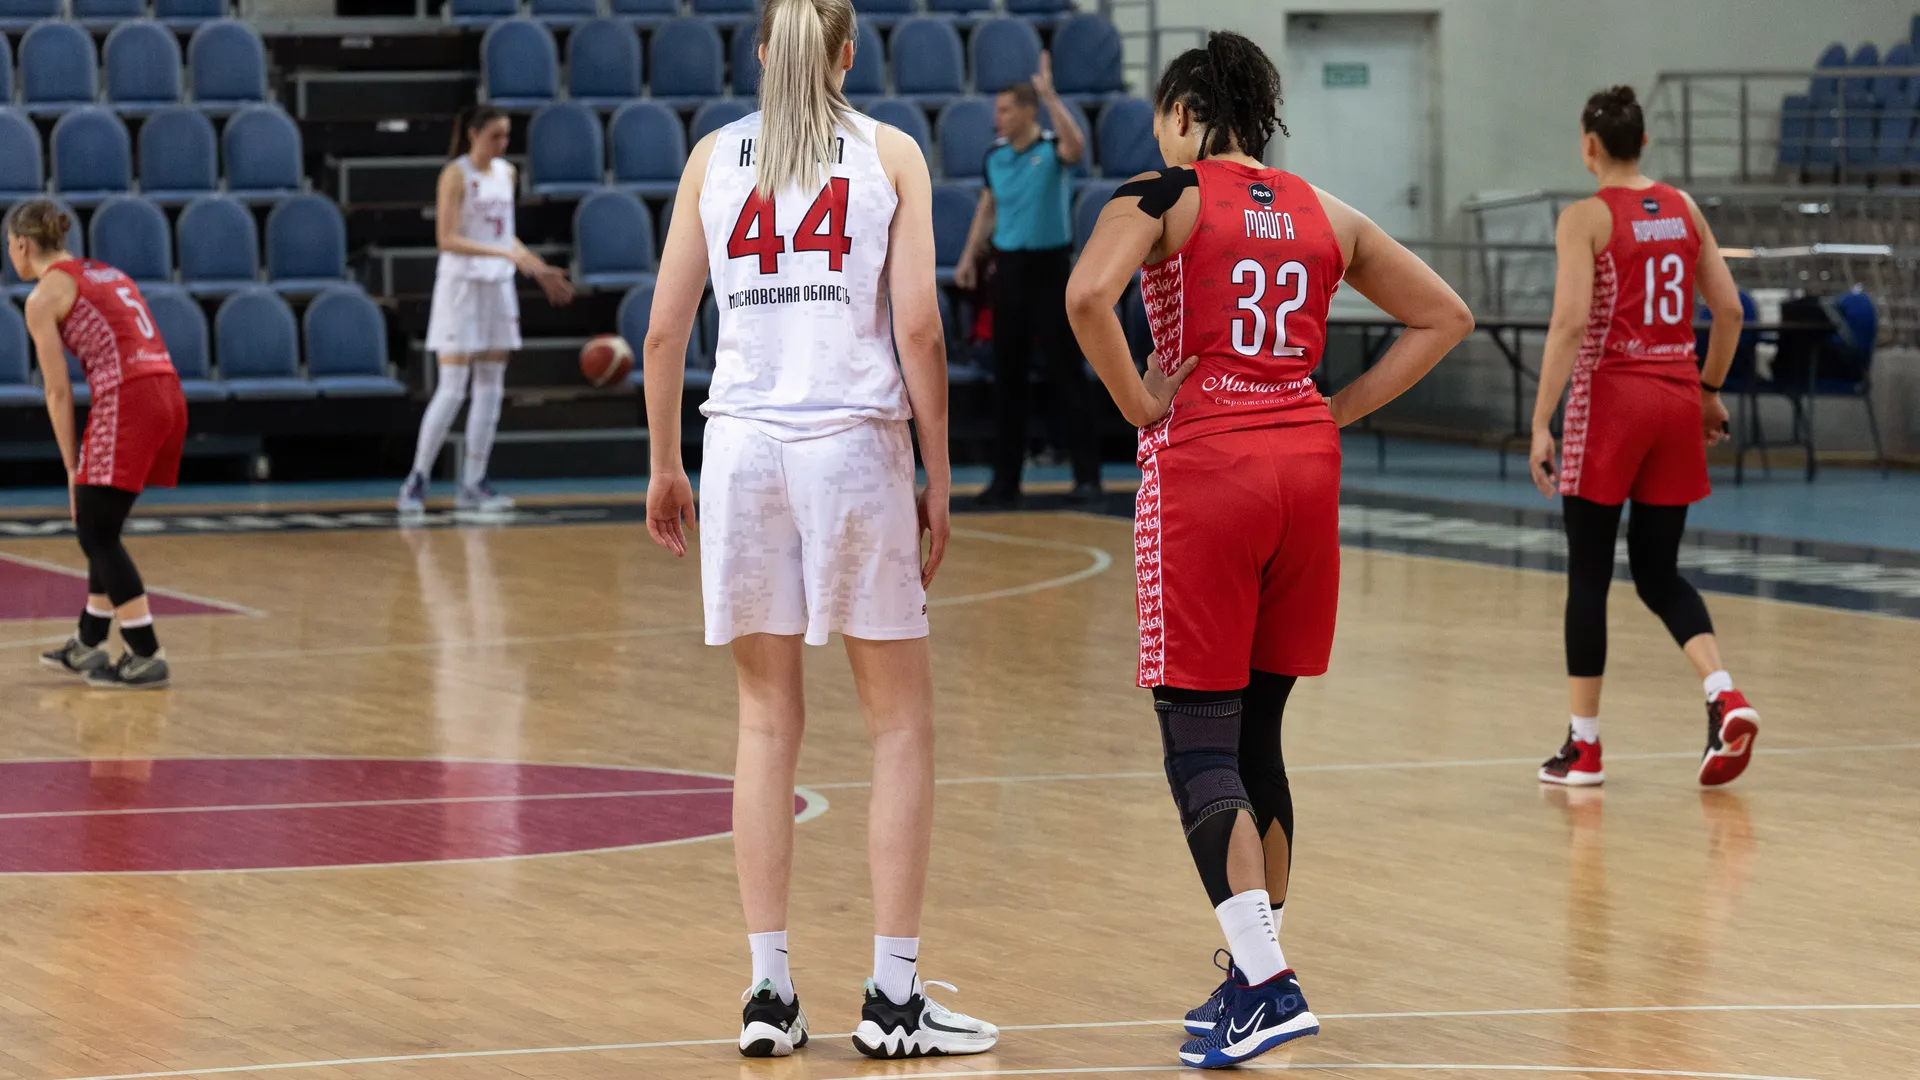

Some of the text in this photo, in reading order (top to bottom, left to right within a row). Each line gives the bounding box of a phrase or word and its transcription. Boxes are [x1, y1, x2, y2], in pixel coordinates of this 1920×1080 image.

[1252, 189, 1272, 198] РФБ
[727, 176, 853, 275] 44
[1244, 205, 1295, 240] МАЙГА
[115, 287, 154, 339] 5
[728, 284, 851, 309] МОСКОВСКАЯ ОБЛАСТЬ
[1231, 258, 1309, 358] 32
[1643, 253, 1685, 325] 13
